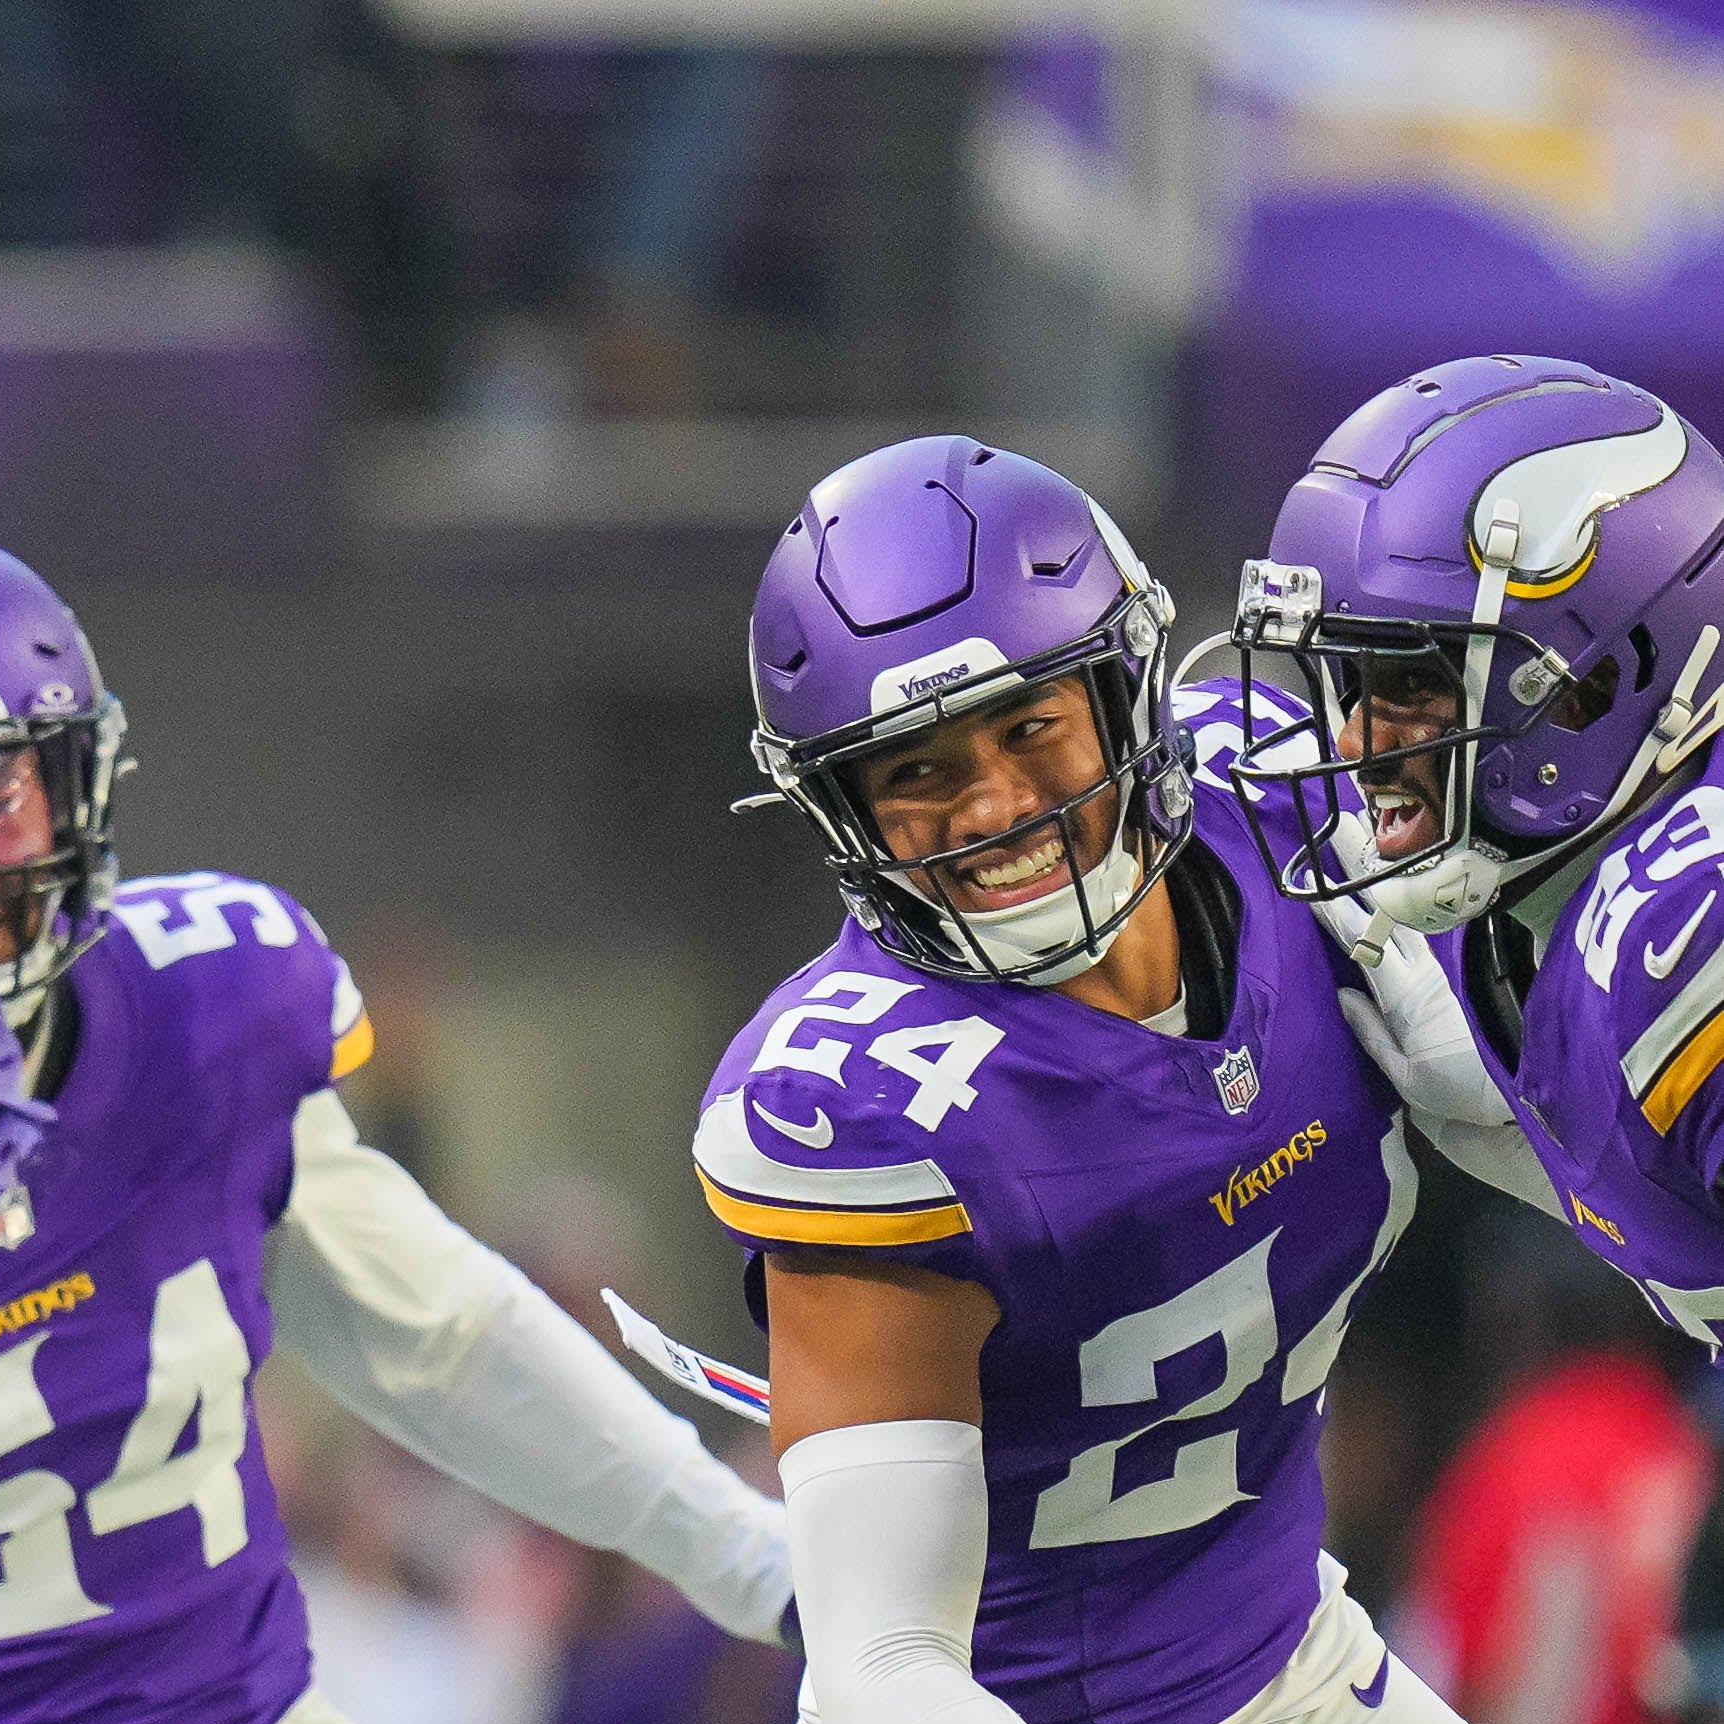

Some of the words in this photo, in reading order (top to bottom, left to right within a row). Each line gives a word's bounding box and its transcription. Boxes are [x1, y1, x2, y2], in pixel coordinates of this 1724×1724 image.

[748, 971, 1006, 1133] 24
[1226, 1076, 1254, 1106] NFL
[1208, 1119, 1327, 1226] VIKINGS
[1029, 1108, 1420, 1551] 24
